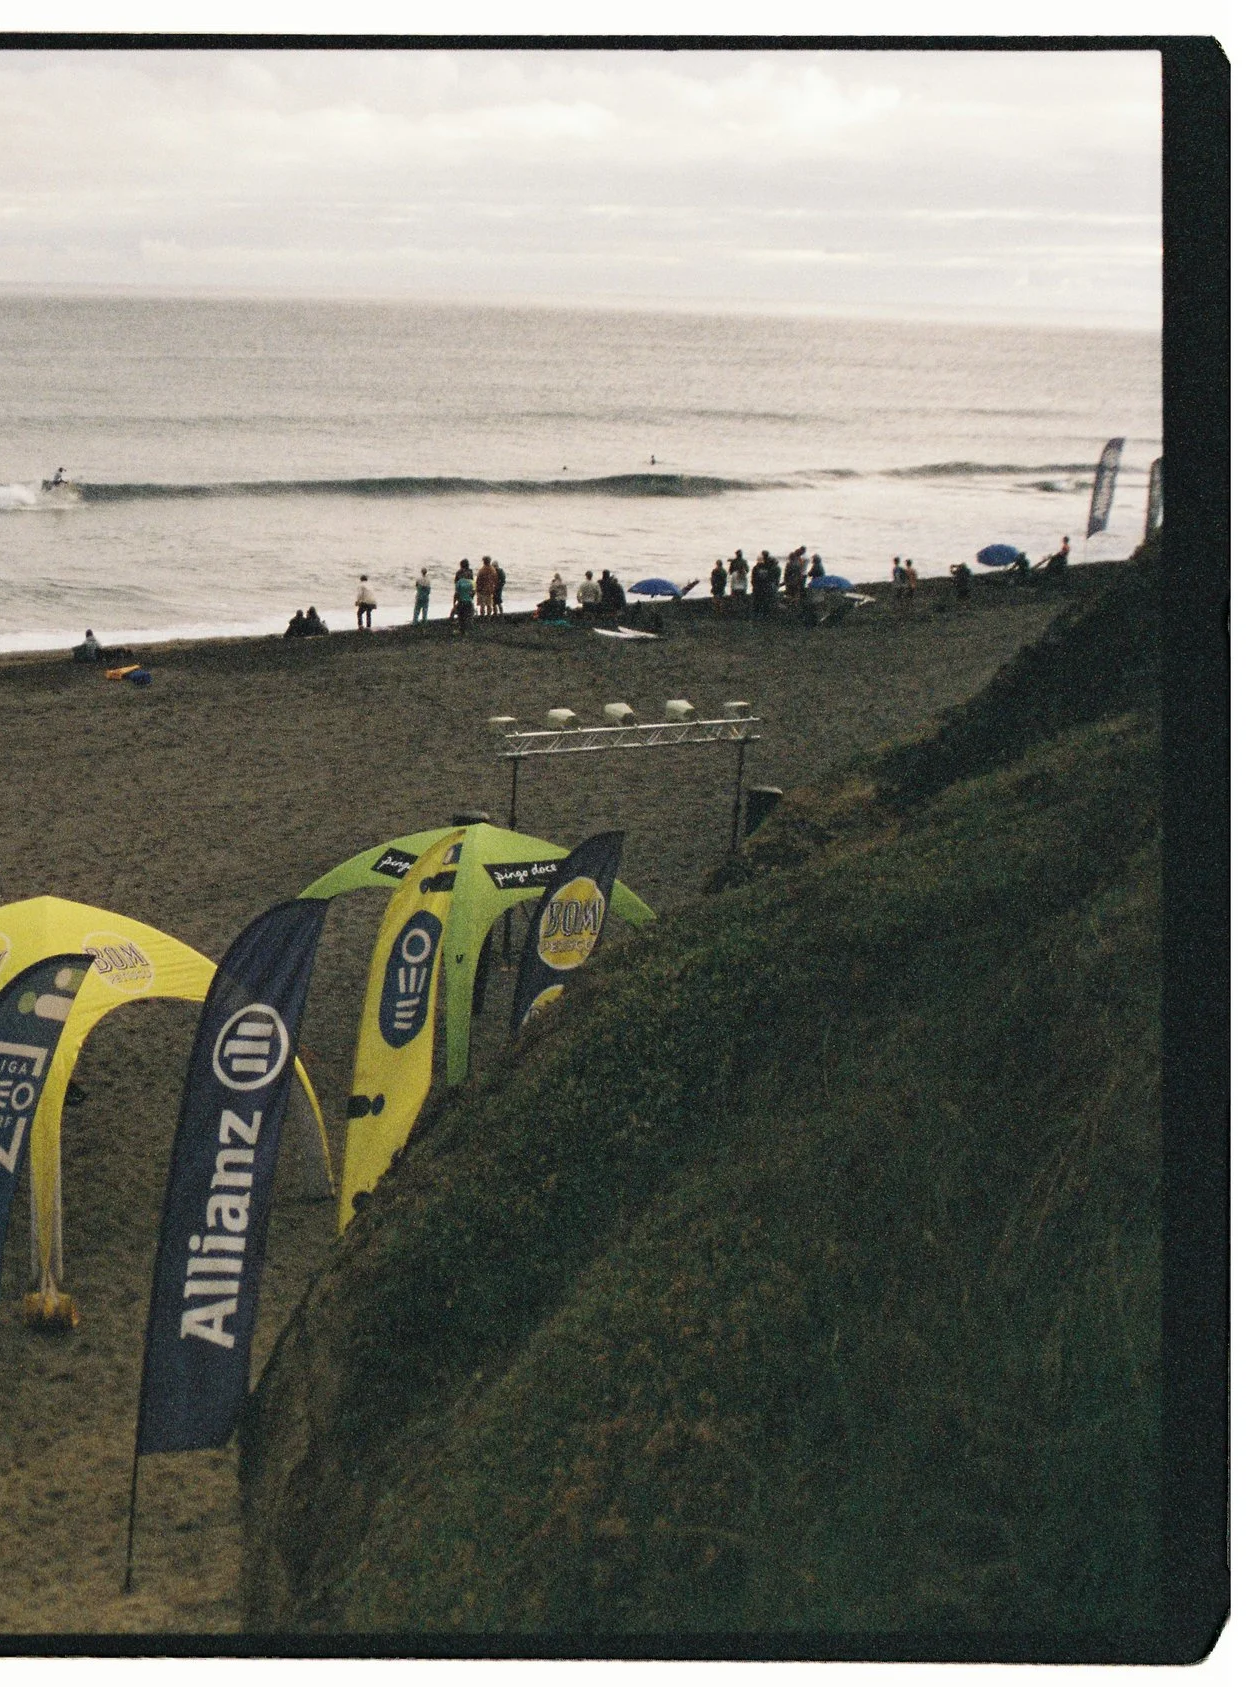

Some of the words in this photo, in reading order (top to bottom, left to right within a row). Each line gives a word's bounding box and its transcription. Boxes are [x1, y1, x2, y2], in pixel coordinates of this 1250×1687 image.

[494, 868, 529, 886] pingo
[532, 862, 558, 874] doce
[85, 941, 151, 974] BOM
[180, 1109, 263, 1350] Allianz
